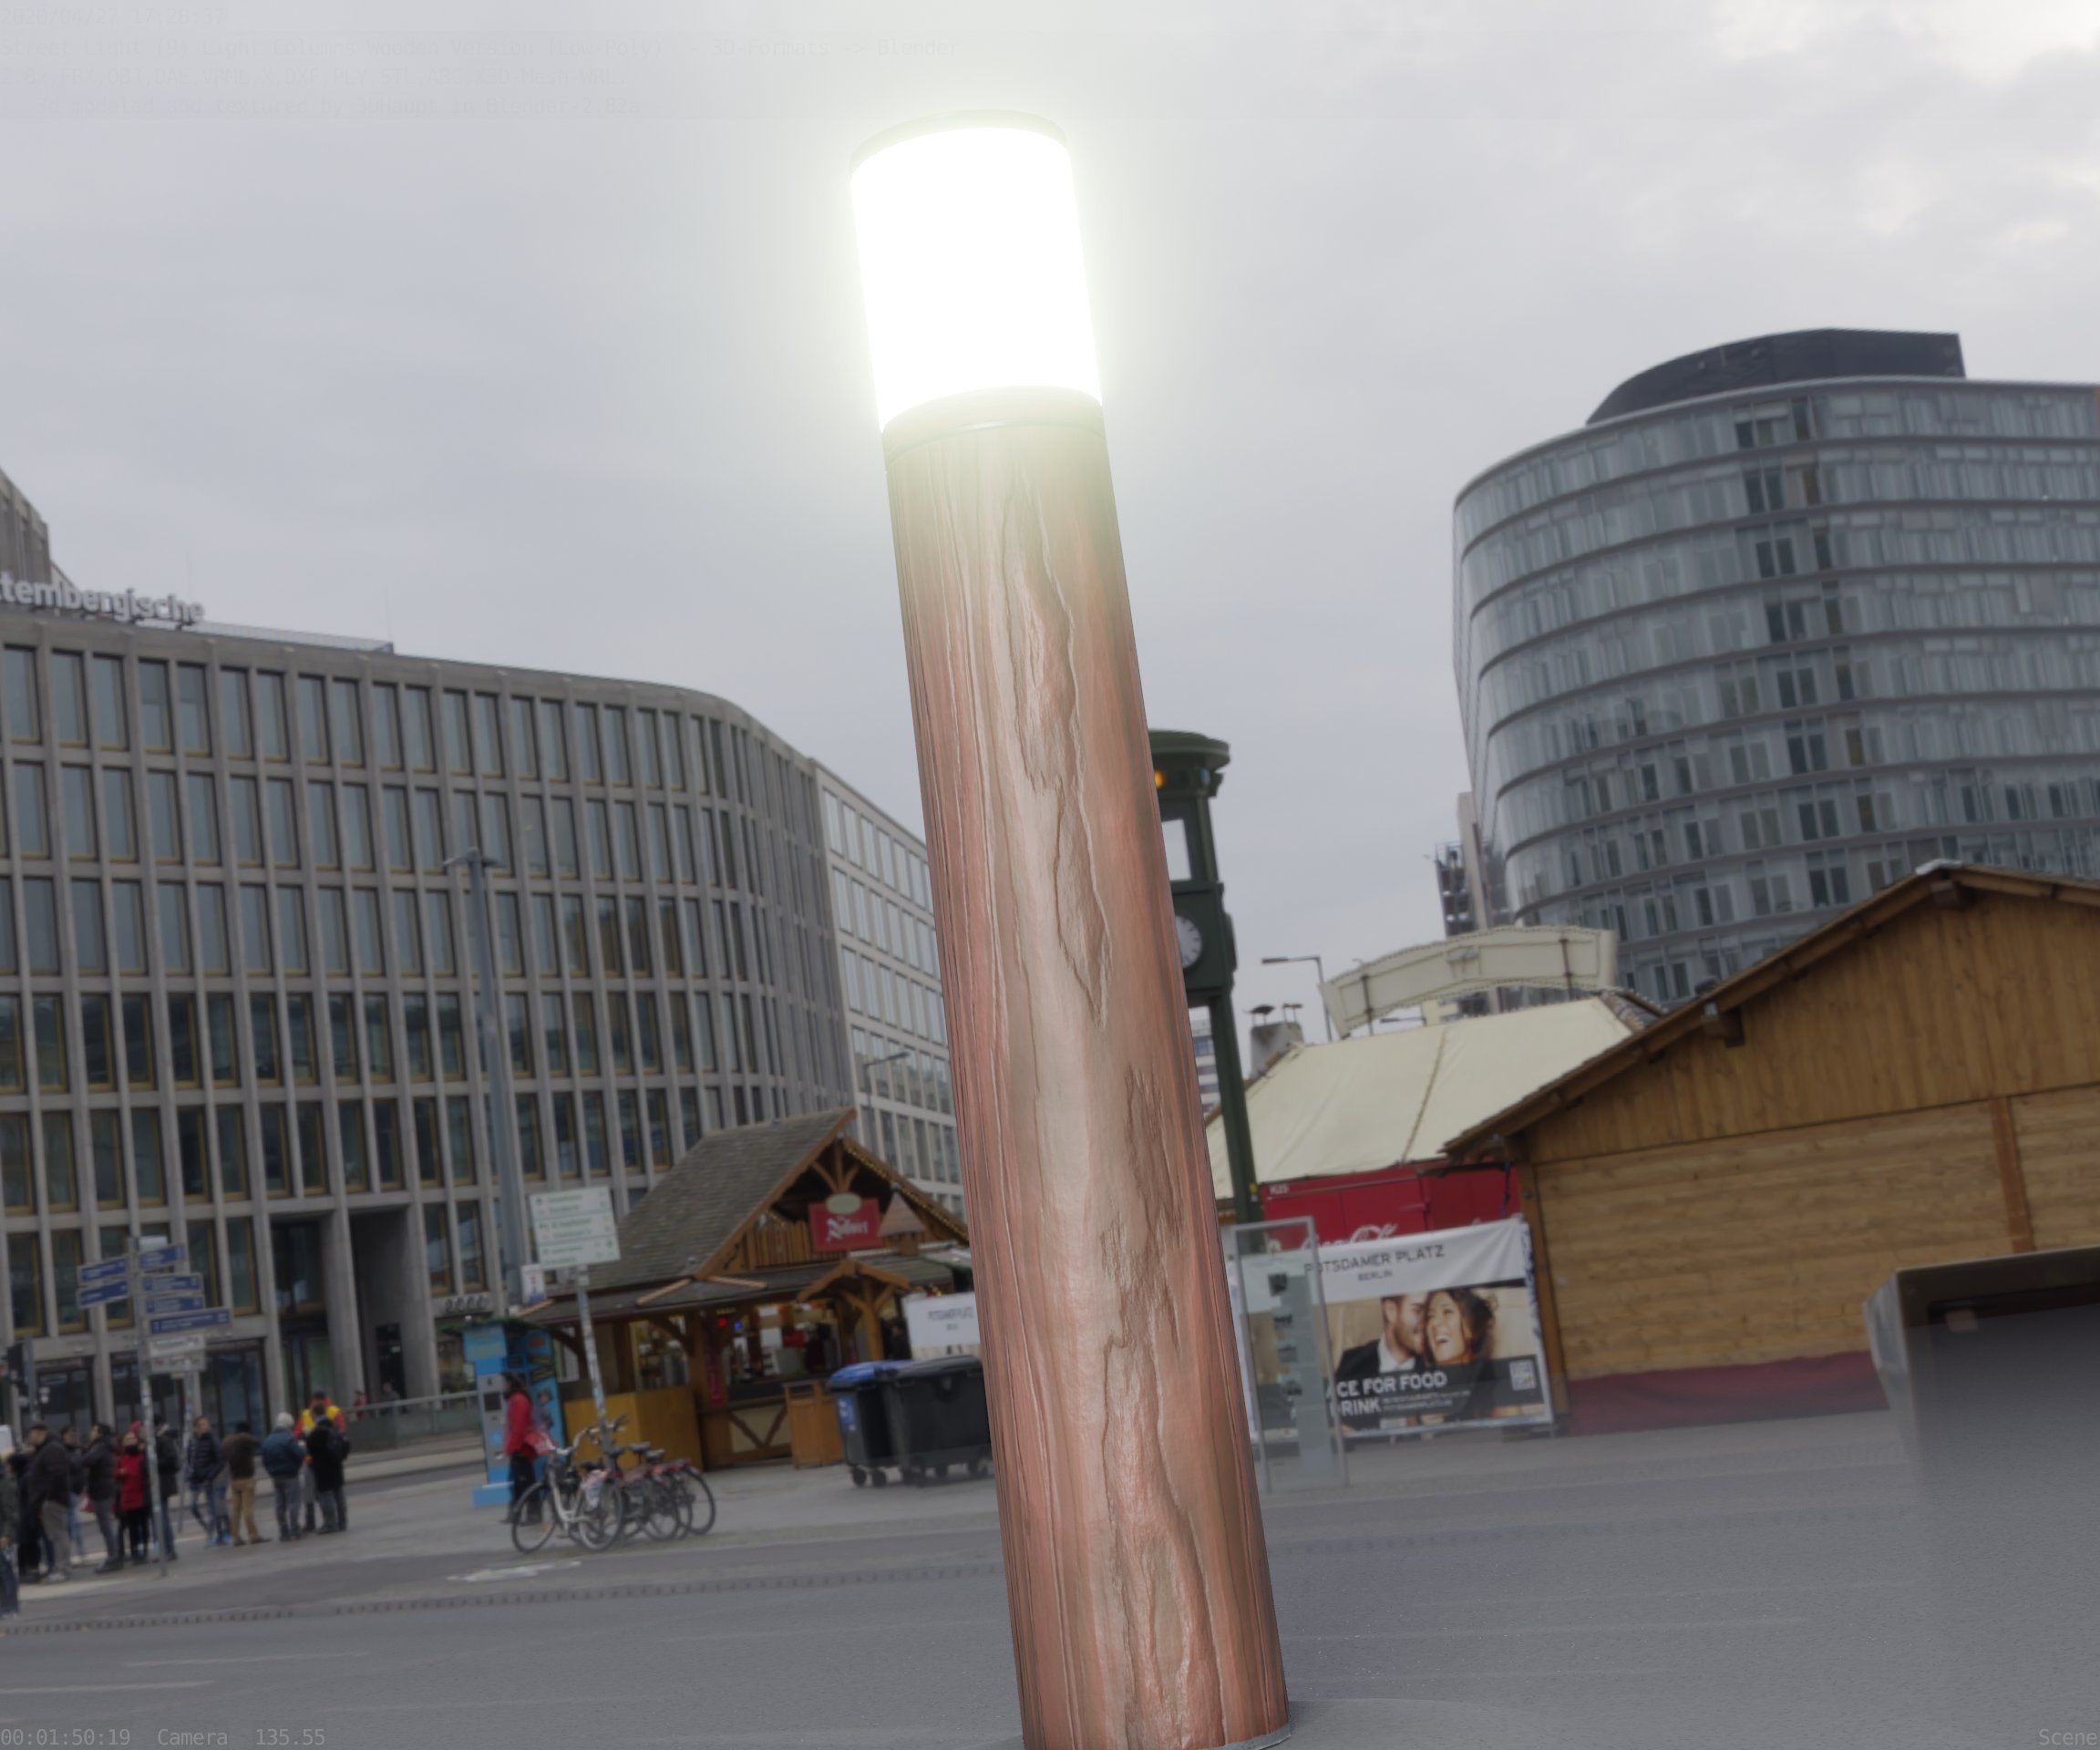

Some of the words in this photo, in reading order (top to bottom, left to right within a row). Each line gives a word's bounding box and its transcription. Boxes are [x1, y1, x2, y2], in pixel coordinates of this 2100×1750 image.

[0, 571, 205, 623] tembergische
[1395, 1244, 1445, 1262] PLATZ
[1362, 1375, 1396, 1394] FOR
[1400, 1371, 1447, 1390] FOOD
